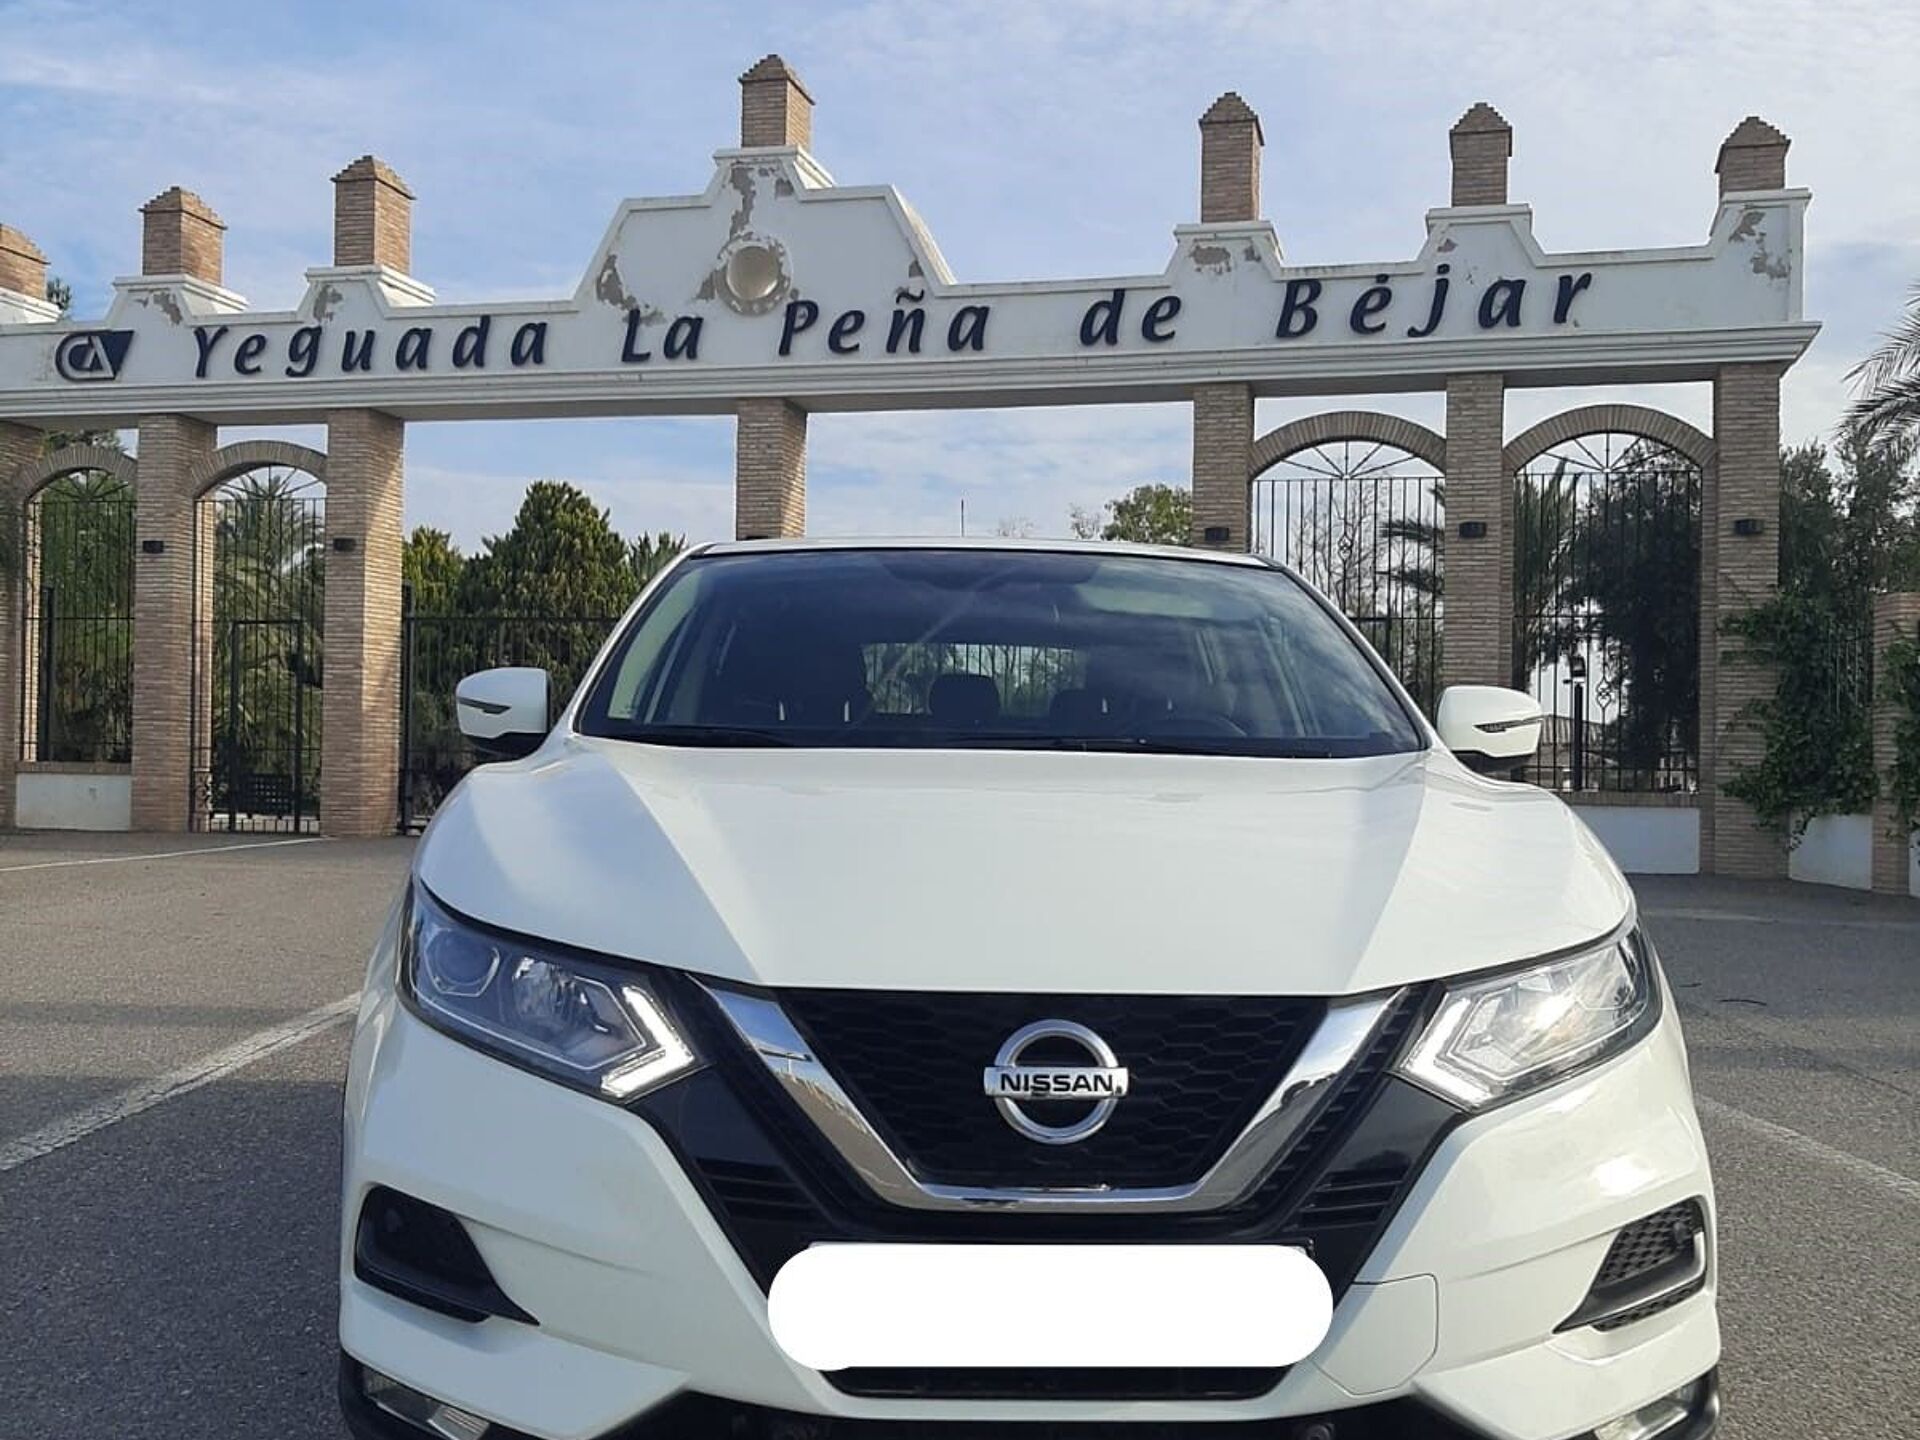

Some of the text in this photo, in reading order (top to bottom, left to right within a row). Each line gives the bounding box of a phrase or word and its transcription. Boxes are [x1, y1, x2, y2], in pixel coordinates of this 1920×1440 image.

[193, 315, 548, 379] Yeguada
[622, 307, 705, 364] La
[779, 289, 991, 357] Peña
[1080, 288, 1183, 347] de
[1001, 1073, 1113, 1092] NISSAN
